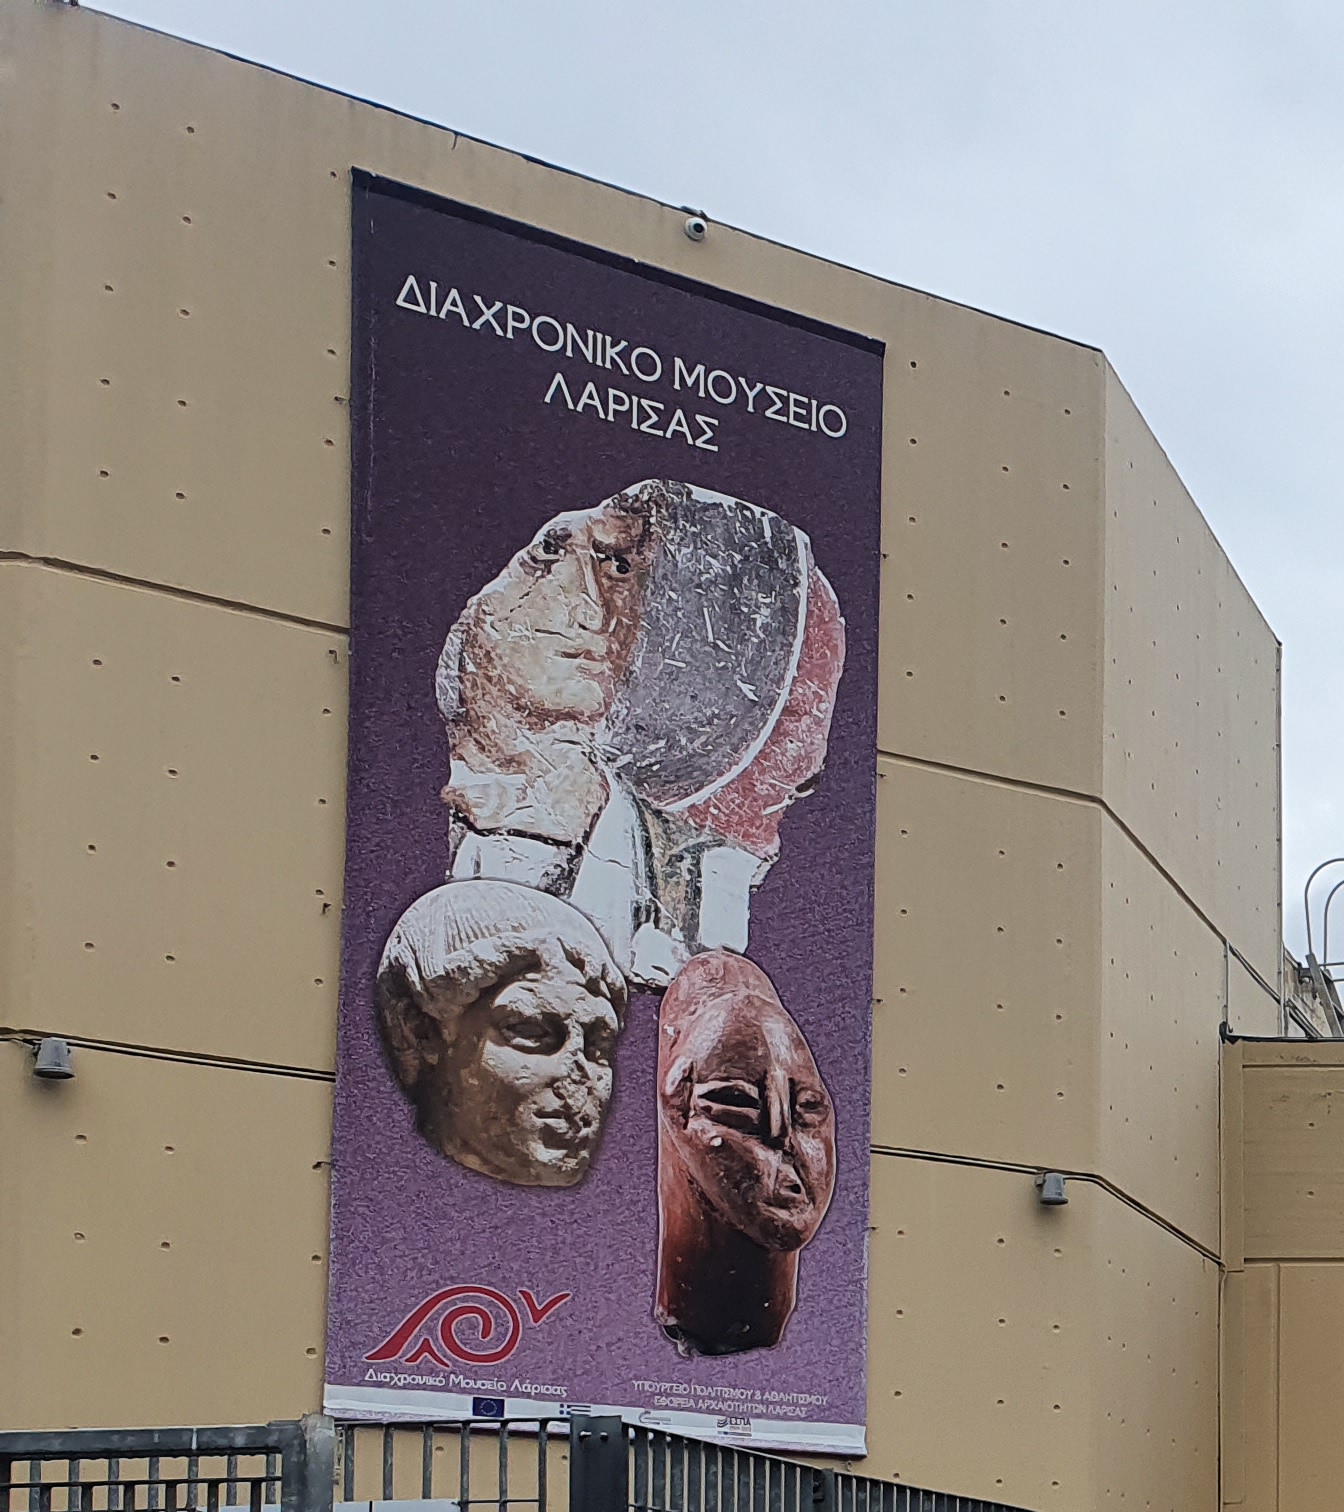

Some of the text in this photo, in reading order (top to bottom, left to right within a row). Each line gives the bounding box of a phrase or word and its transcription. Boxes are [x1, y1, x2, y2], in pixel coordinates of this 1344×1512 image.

[395, 275, 848, 439] ΔΙΑΧΡΟΝΙΚΟ ΜΟΥΣΕΙΟ
[544, 373, 720, 452] ΛΑΡΙΣΑΣ
[364, 1368, 568, 1398] Διαχρονικό Μουσείο Λάρισας
